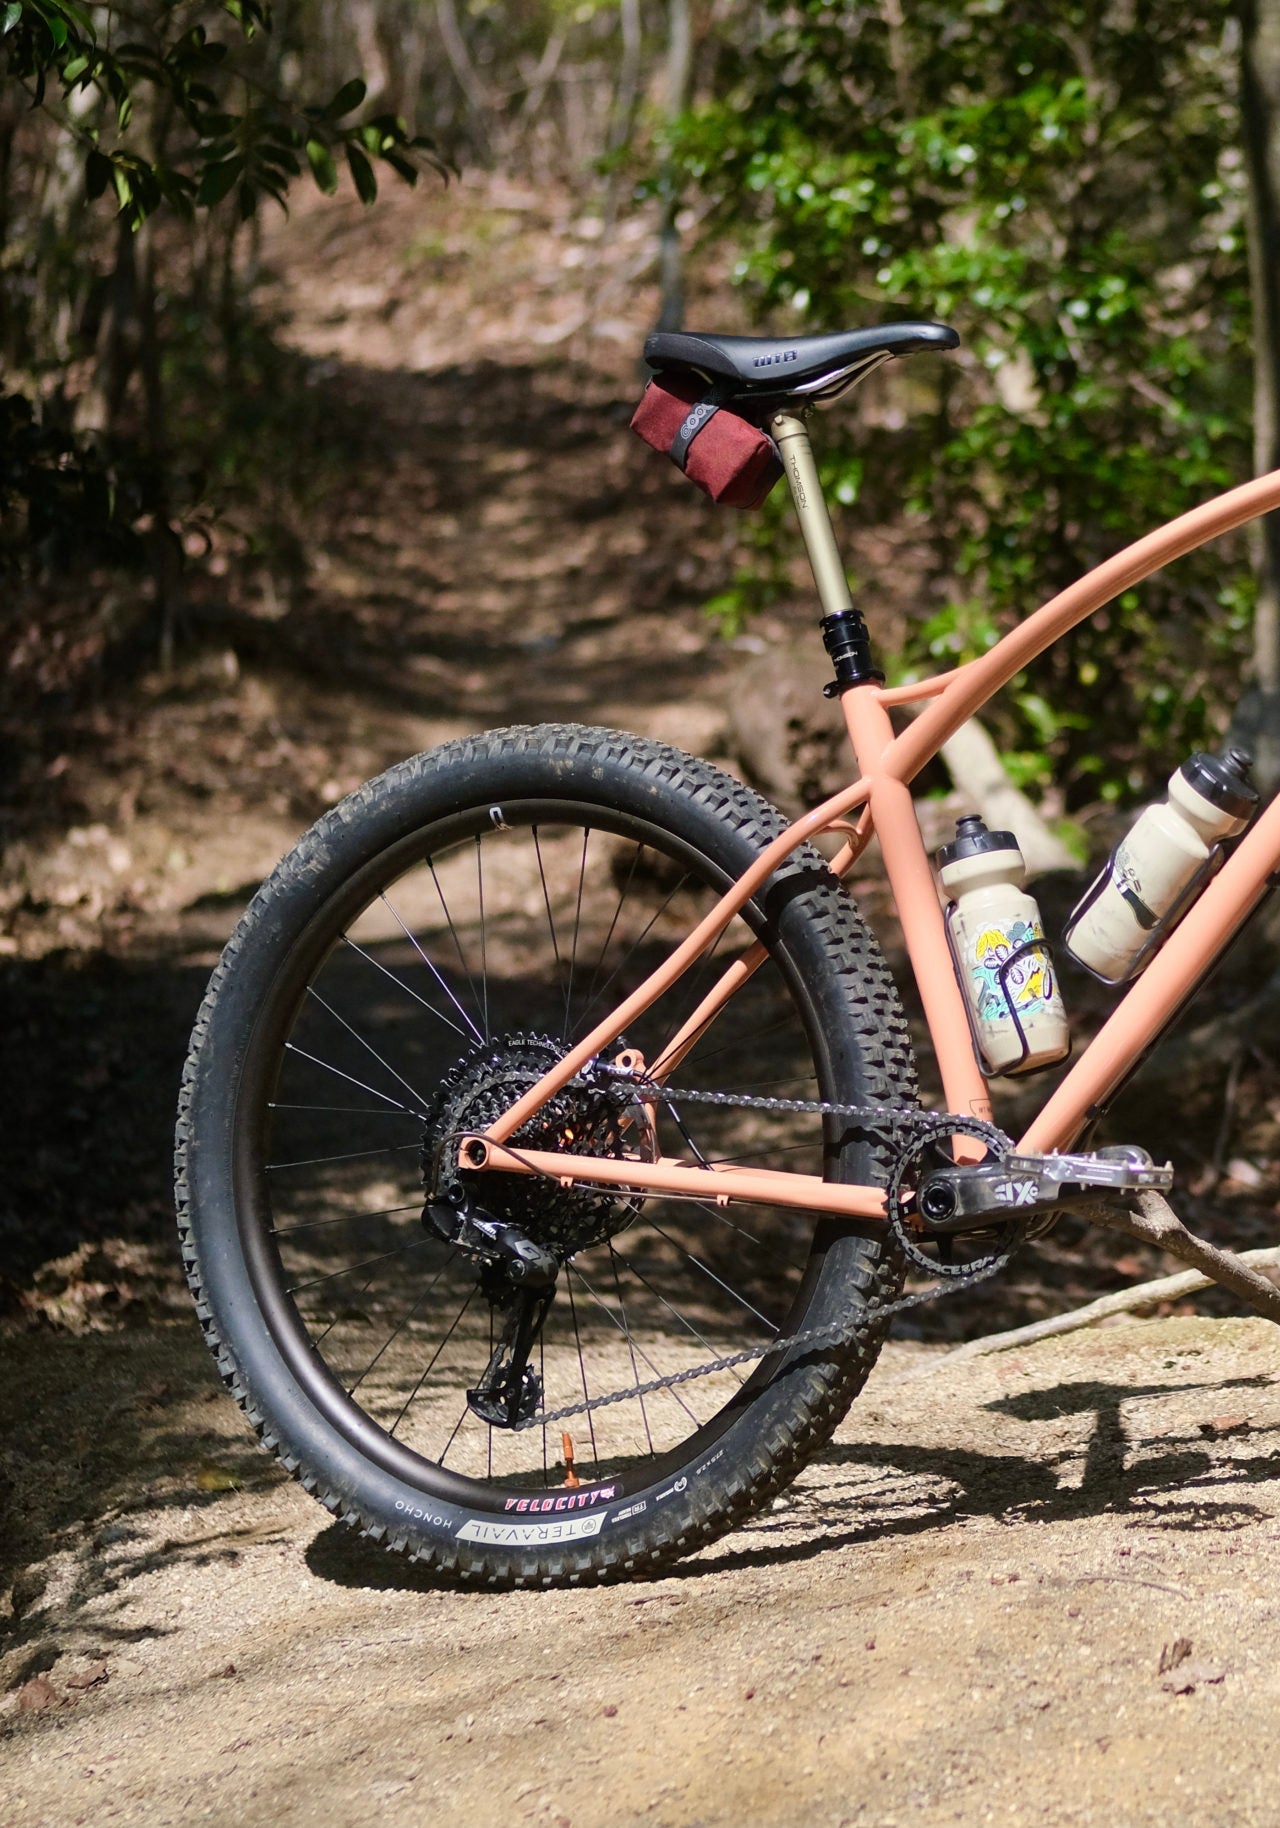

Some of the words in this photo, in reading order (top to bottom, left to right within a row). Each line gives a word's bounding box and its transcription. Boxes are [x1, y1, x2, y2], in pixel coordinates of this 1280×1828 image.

[754, 350, 798, 368] WTB
[789, 453, 809, 510] THOMSON
[508, 1039, 526, 1048] EAGLE
[504, 1492, 600, 1512] VELOCITY
[394, 1499, 453, 1529] HONCHO
[470, 1524, 577, 1541] TERAVAIL
